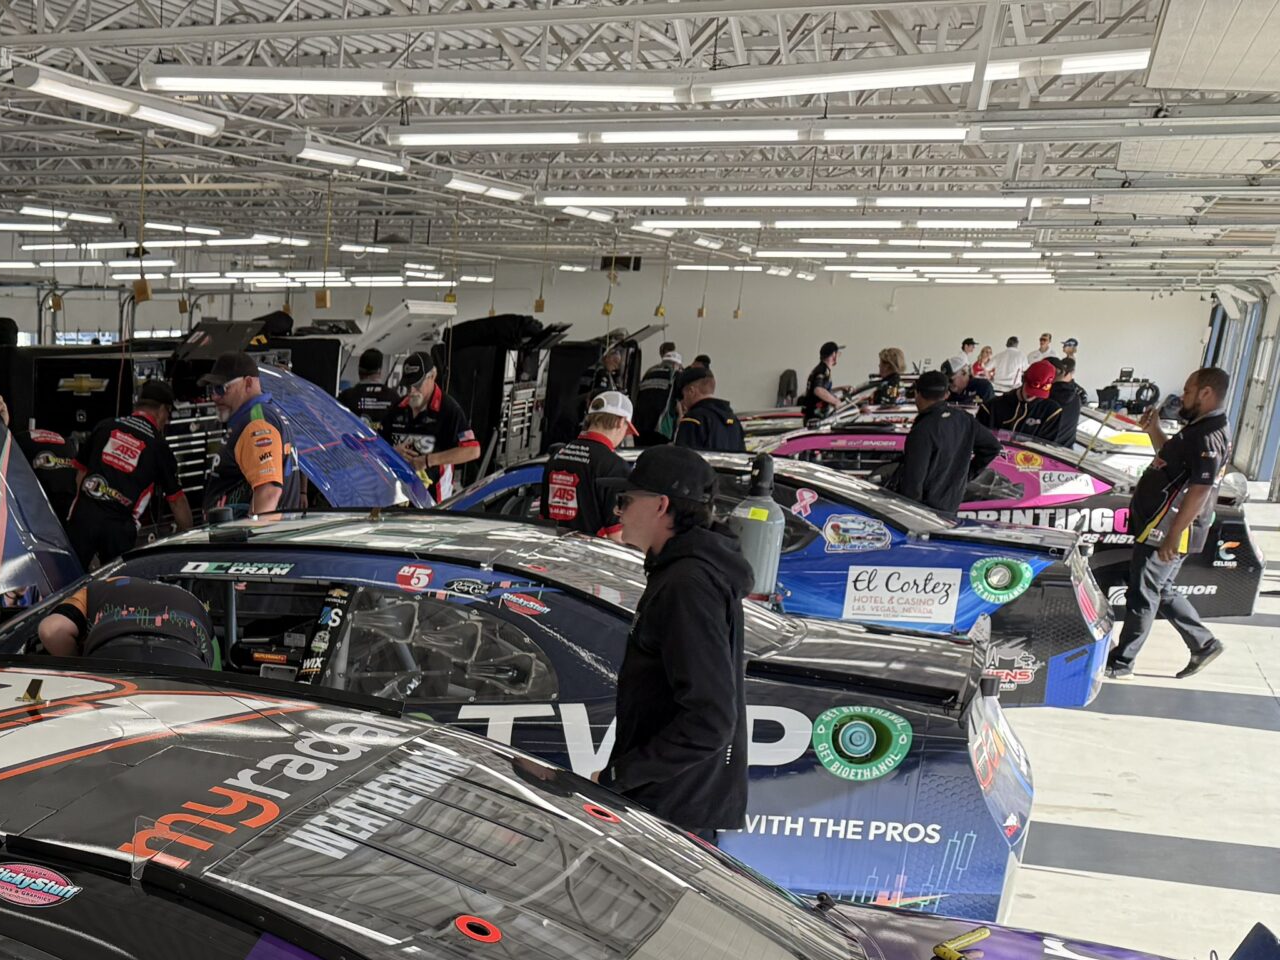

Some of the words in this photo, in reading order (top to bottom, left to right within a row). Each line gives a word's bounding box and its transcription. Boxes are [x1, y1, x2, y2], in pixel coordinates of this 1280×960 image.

[1213, 560, 1238, 568] CELSIUS
[227, 566, 291, 576] CRAM
[852, 568, 879, 592] El
[885, 571, 952, 605] Cortez
[853, 595, 885, 605] HOTEL
[887, 595, 895, 605] &
[896, 596, 935, 606] CASINO
[851, 604, 866, 612] LAS
[902, 606, 933, 615] NEVADA
[302, 657, 324, 670] WIX
[817, 741, 834, 765] GET
[830, 751, 903, 780] BIOETHANOL
[113, 711, 412, 871] myradar
[283, 747, 478, 861] WEATHERMAN
[809, 817, 865, 840] THE
[868, 819, 943, 845] PROS
[20, 890, 52, 903] GRAPHICS
